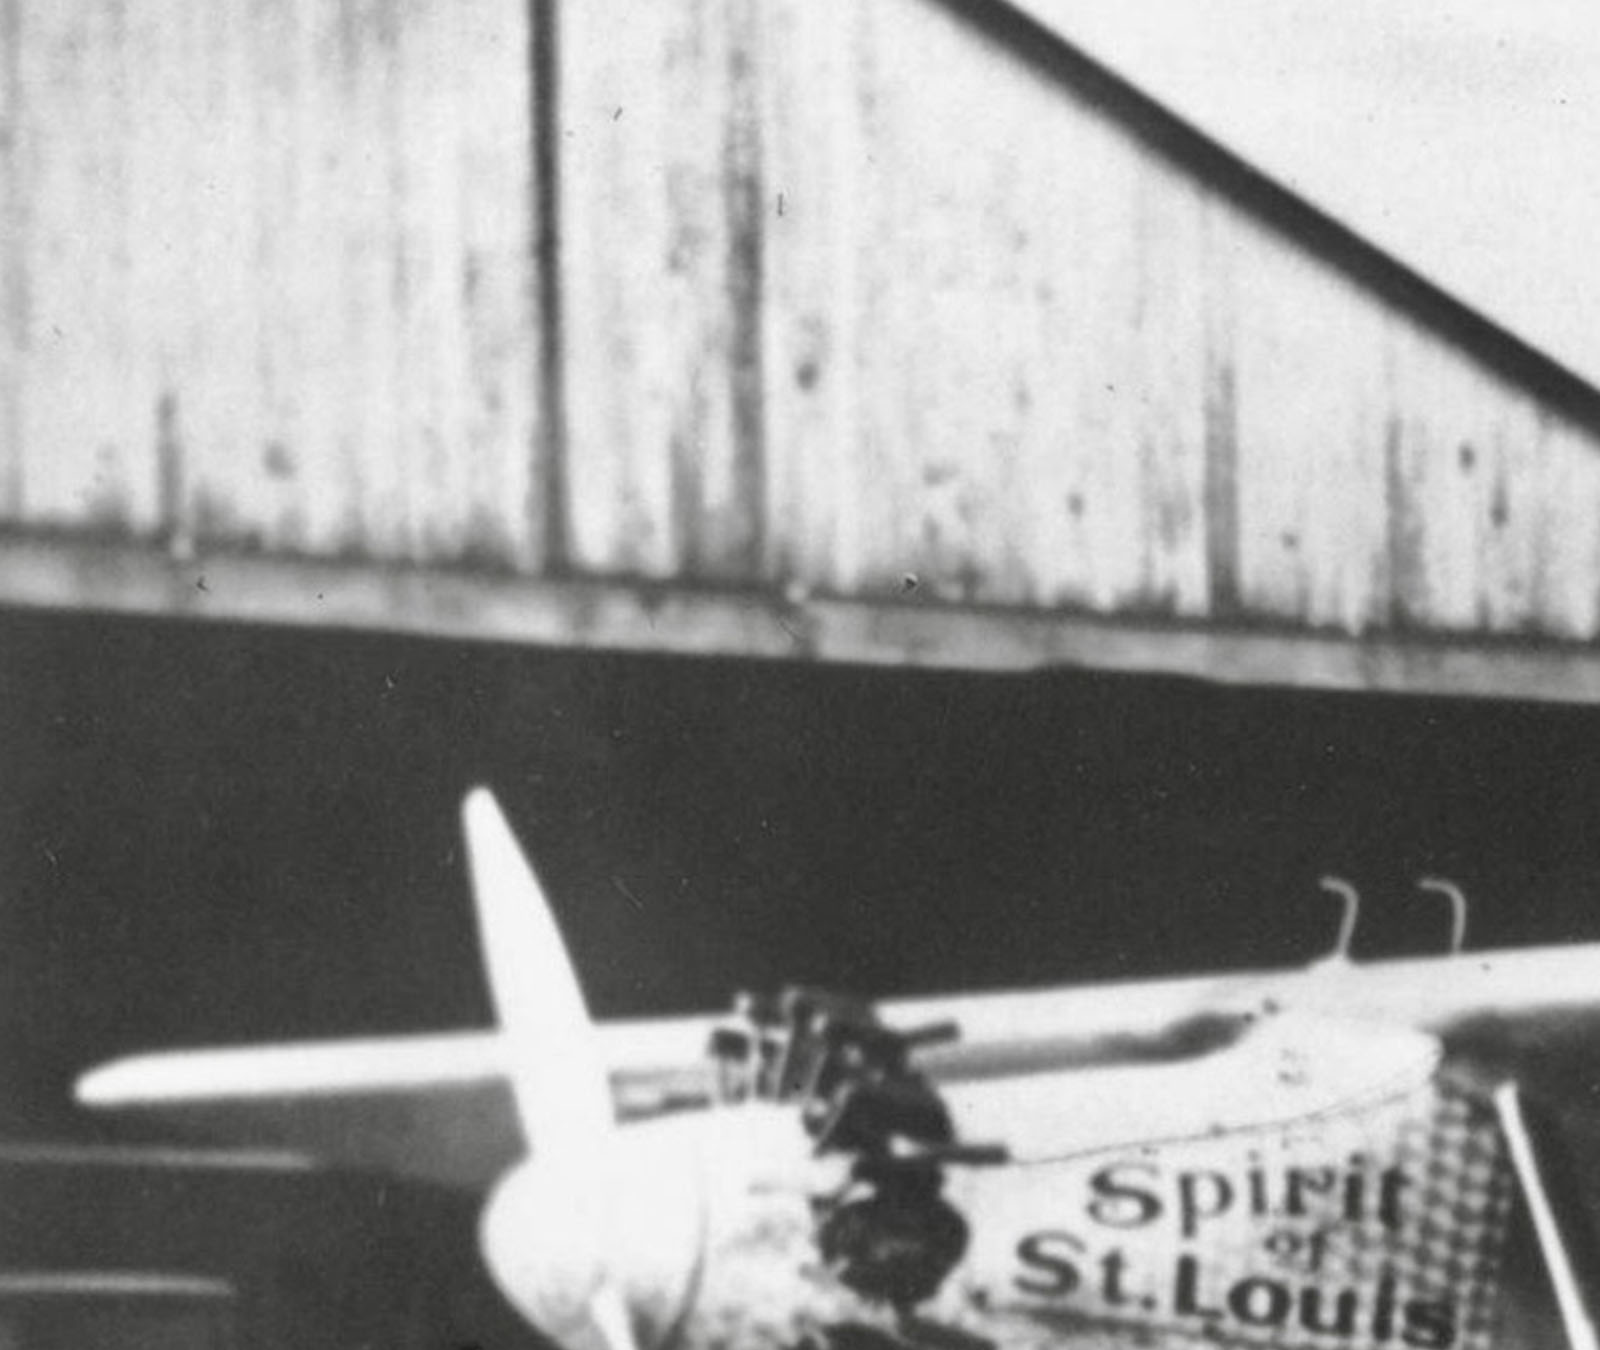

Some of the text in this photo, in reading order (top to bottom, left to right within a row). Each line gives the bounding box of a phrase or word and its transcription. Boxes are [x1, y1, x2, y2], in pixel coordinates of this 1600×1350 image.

[1086, 1151, 1412, 1237] Spirit
[1264, 1222, 1332, 1272] of
[1172, 1252, 1458, 1350] Louis
